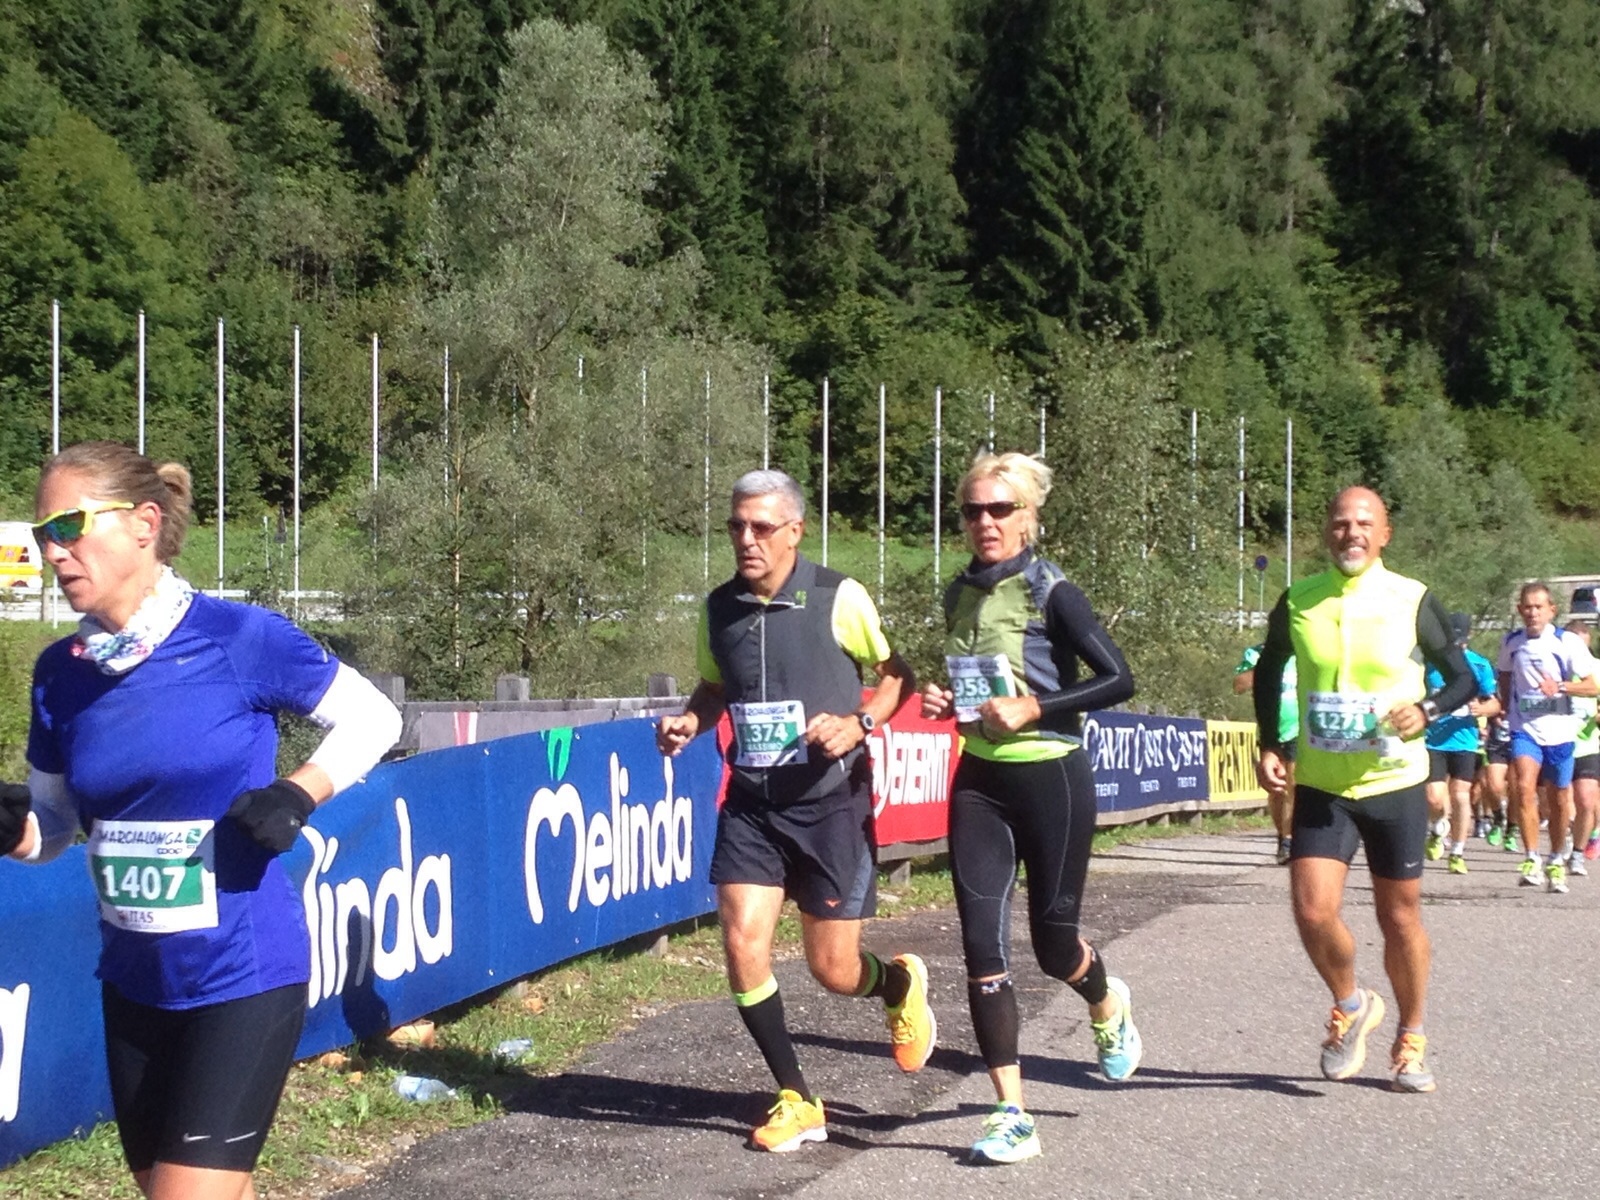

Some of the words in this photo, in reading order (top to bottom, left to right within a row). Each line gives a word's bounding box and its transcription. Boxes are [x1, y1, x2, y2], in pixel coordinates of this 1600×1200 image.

[1317, 712, 1367, 733] 1271
[1083, 719, 1135, 772] CAVIT
[1095, 783, 1119, 797] TRENTO
[97, 828, 184, 845] MARCIALONGA
[525, 752, 693, 925] Melinda
[102, 864, 187, 901] 1407
[302, 797, 454, 1009] linda
